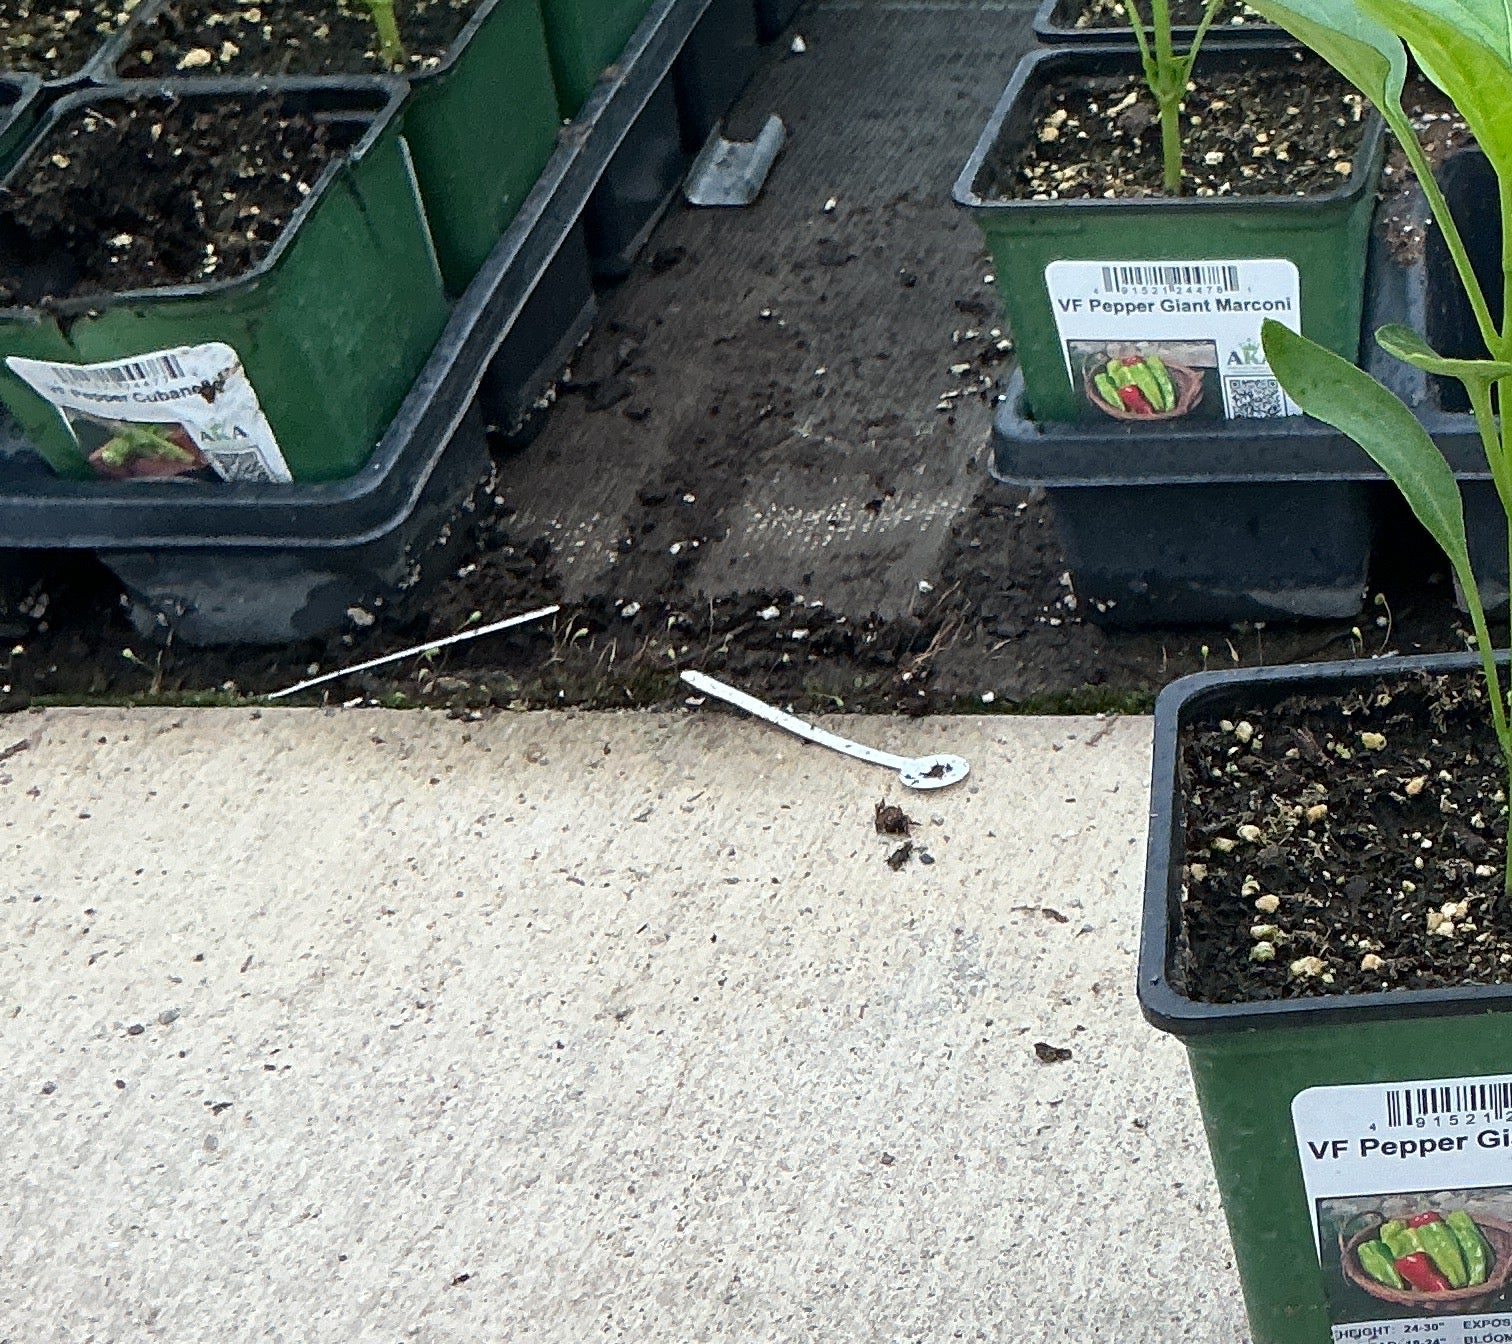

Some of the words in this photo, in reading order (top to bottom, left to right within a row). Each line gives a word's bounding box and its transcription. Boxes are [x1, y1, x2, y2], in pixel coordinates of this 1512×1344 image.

[1058, 298, 1083, 313] VF
[1089, 298, 1155, 316] Pepper
[1160, 298, 1212, 313] Giant
[1216, 297, 1292, 312] Marconi
[1415, 1112, 1491, 1129] 91521
[1307, 1140, 1349, 1160] VF
[1360, 1135, 1469, 1159] Pepper
